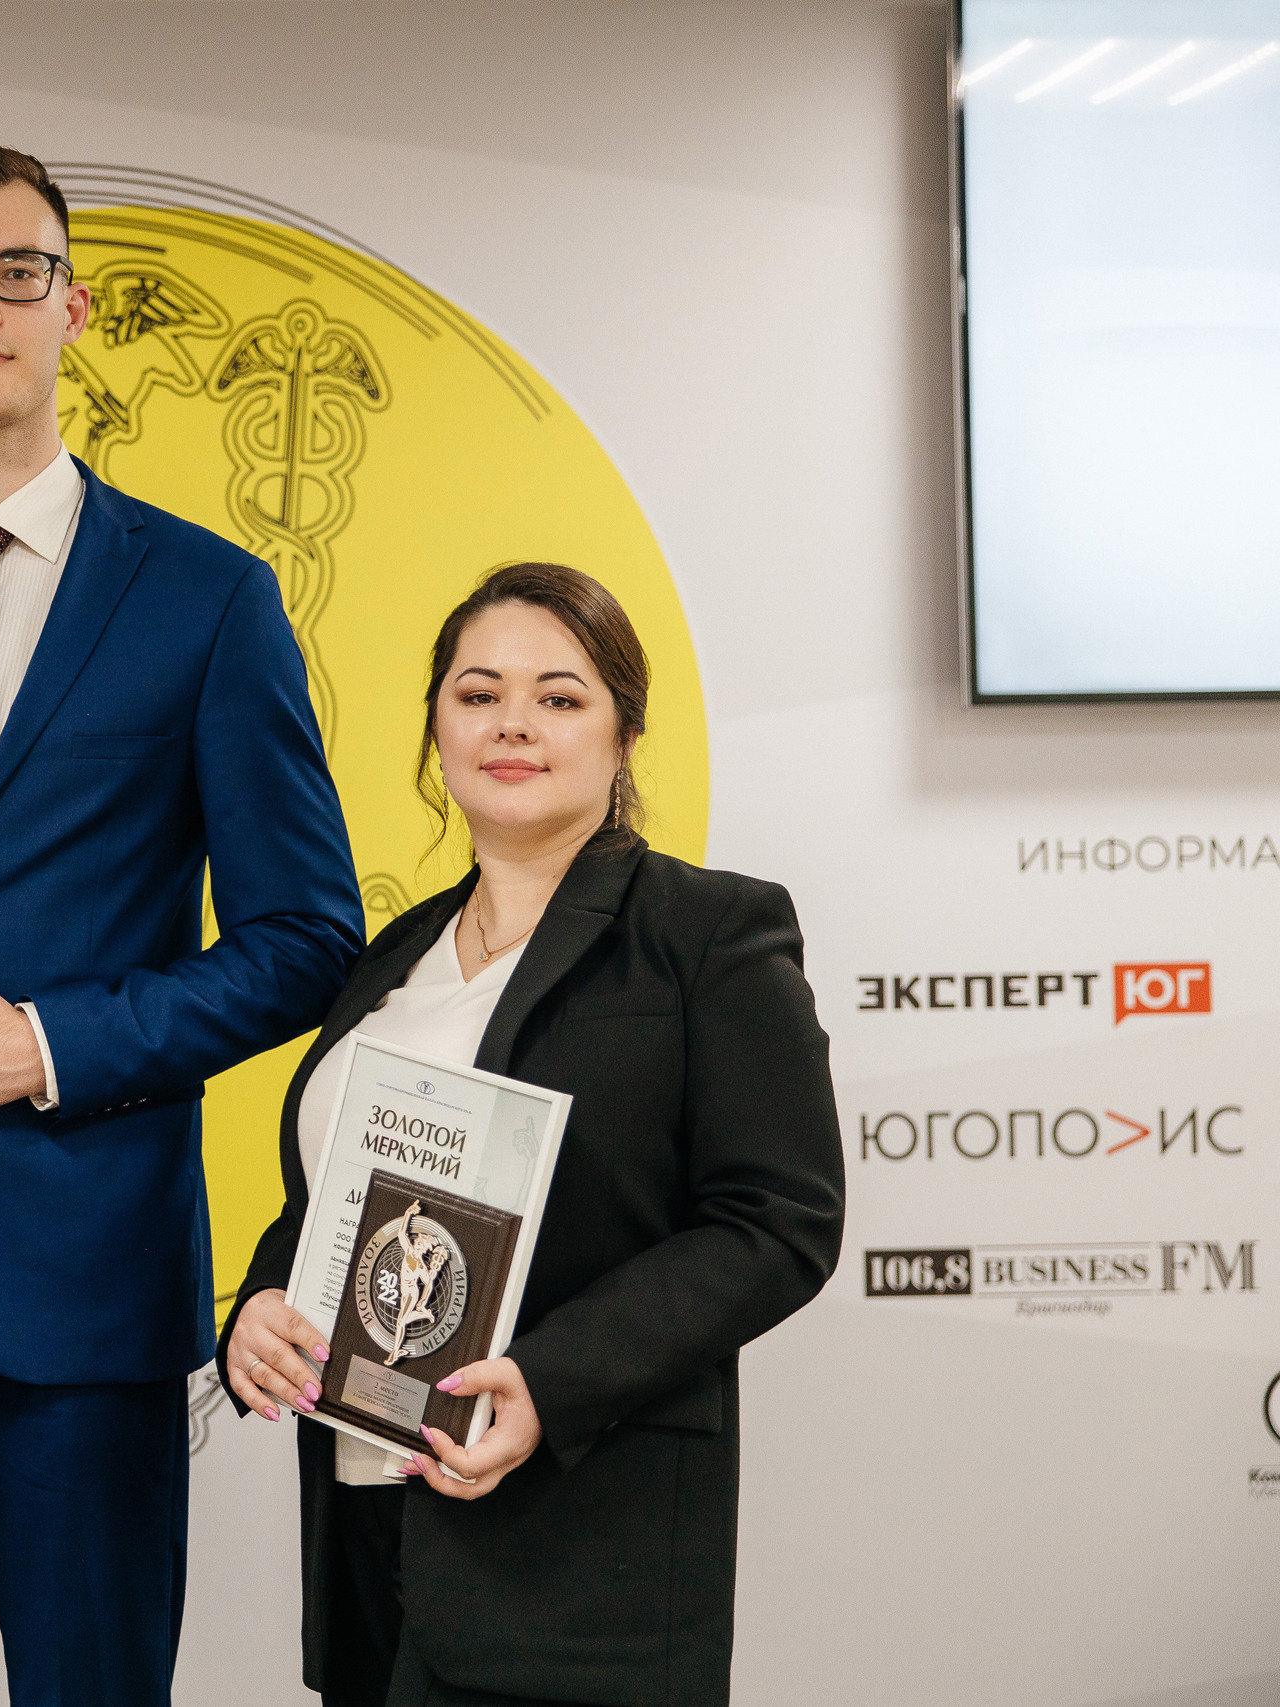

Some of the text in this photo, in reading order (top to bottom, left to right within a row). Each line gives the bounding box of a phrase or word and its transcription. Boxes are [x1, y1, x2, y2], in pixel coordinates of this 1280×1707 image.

[857, 968, 1205, 1012] ЭКСПЕРТ ЮГ
[367, 1104, 467, 1153] ЗОЛОТОЙ
[360, 1130, 461, 1180] МЕРКУРИЙ
[357, 1236, 381, 1325] ЗОЛОТОЙ
[982, 1256, 1149, 1285] BUSINESS
[1158, 1239, 1260, 1294] FM
[421, 1269, 466, 1354] МЕРКУРИЙ
